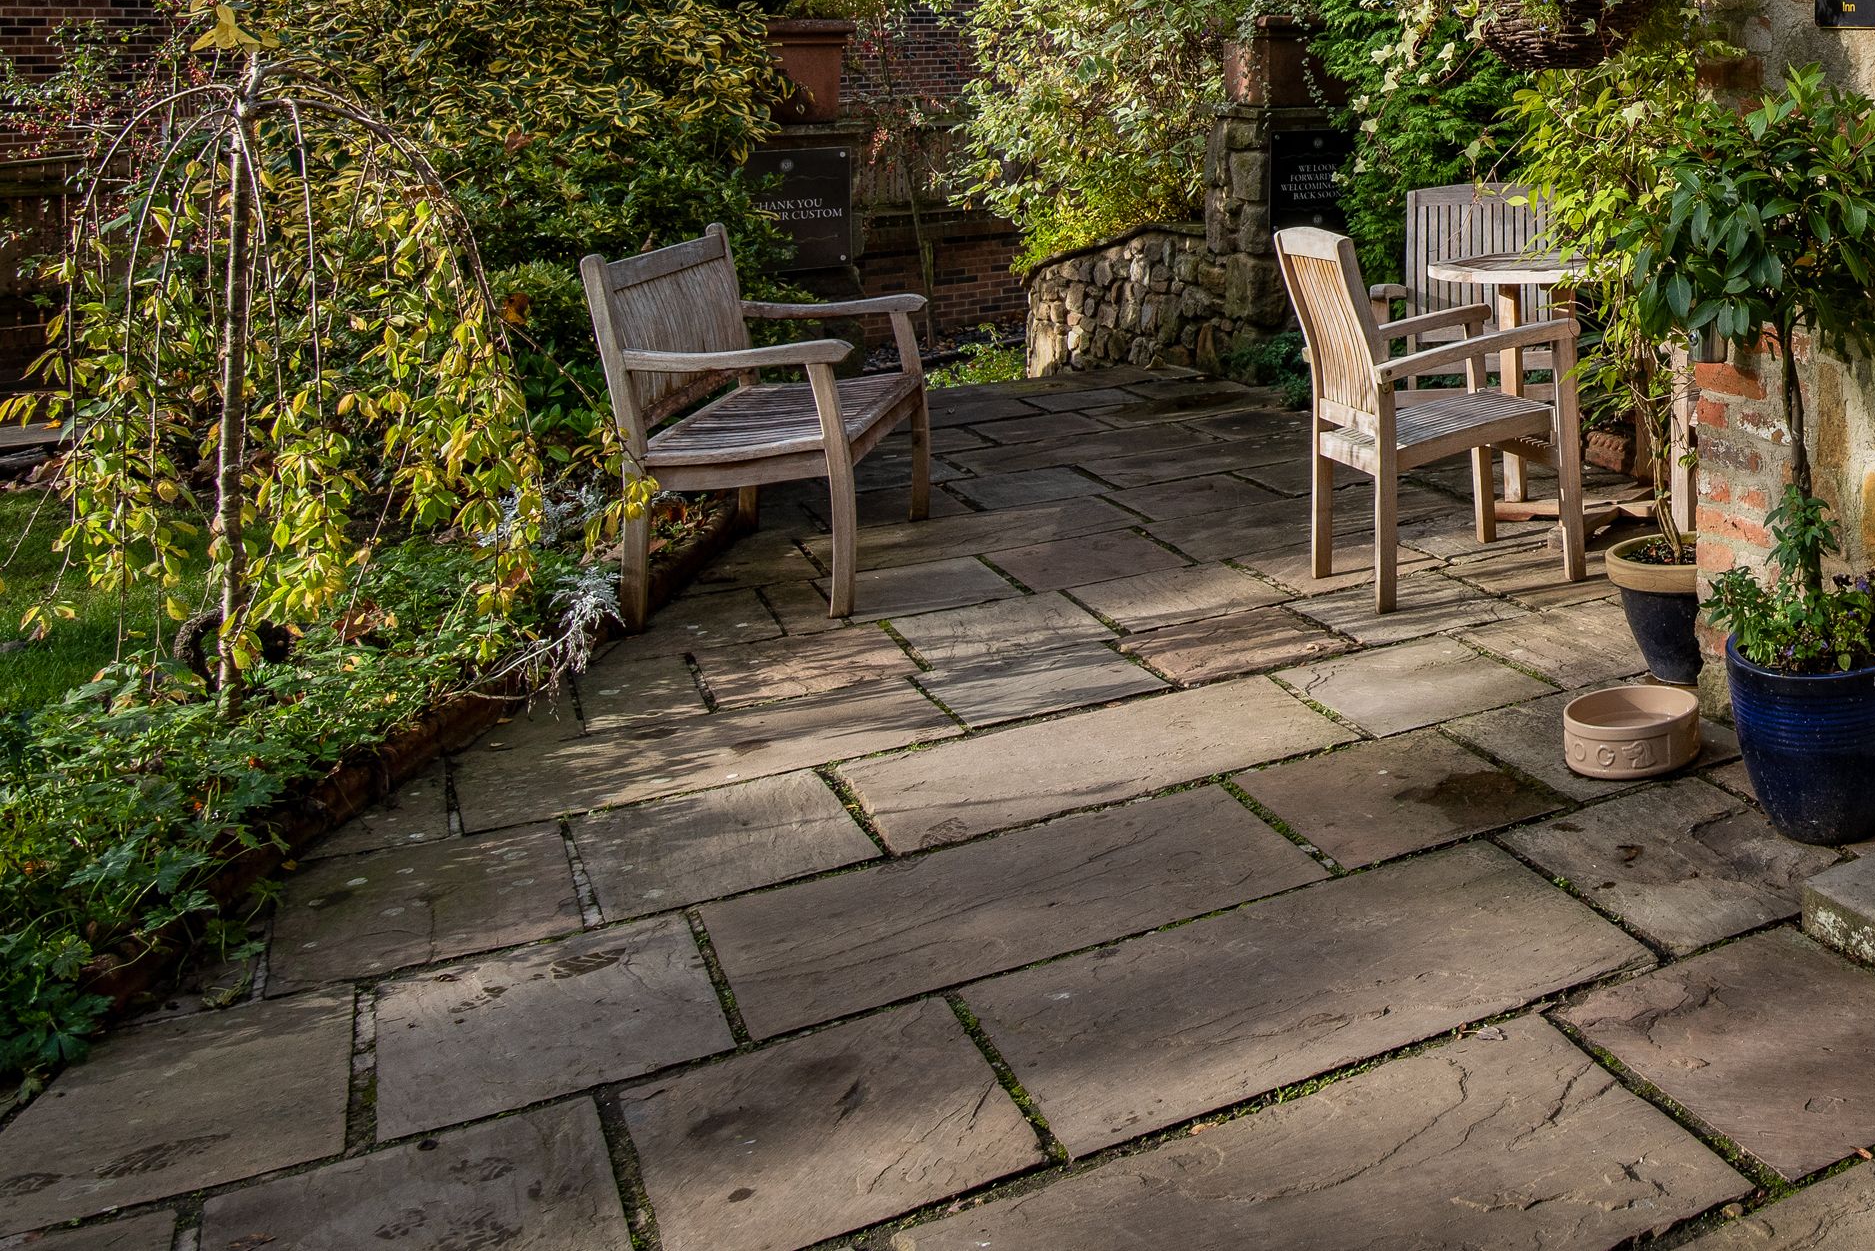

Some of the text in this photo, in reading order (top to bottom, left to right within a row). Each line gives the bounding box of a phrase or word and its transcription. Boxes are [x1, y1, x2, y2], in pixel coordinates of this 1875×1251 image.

[1842, 1, 1856, 13] Inn
[1298, 163, 1337, 173] WE LOOK
[1293, 190, 1342, 200] BACK SOON
[797, 198, 823, 209] YOU
[792, 207, 842, 220] CUSTOM
